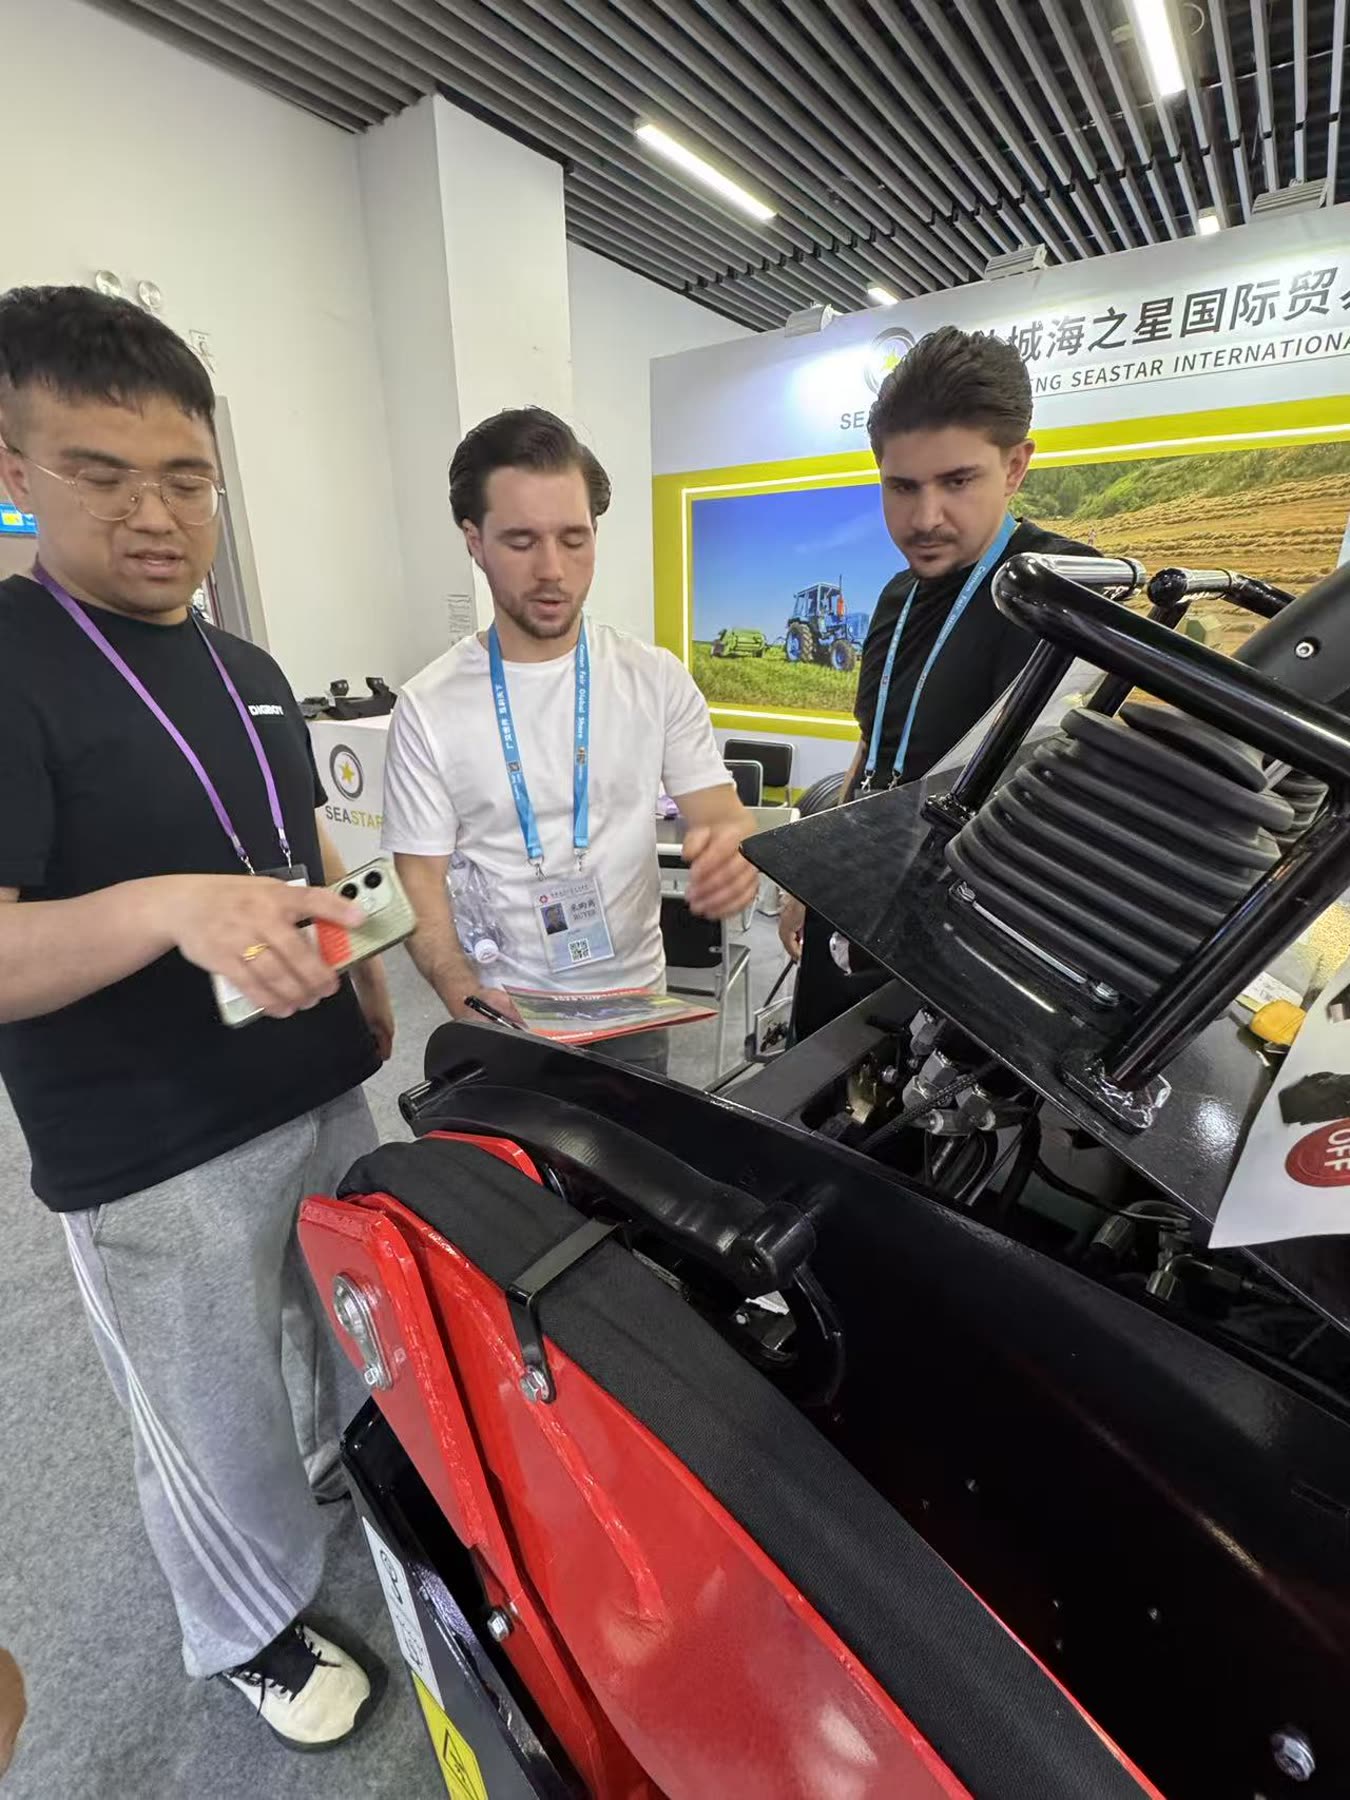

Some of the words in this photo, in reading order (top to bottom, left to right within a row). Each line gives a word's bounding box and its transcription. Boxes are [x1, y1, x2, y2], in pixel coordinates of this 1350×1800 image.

[979, 266, 1350, 366] 城海之星国际贸
[1030, 374, 1062, 393] NG
[1071, 359, 1164, 388] SEASTAR
[1324, 1128, 1350, 1171] OFF
